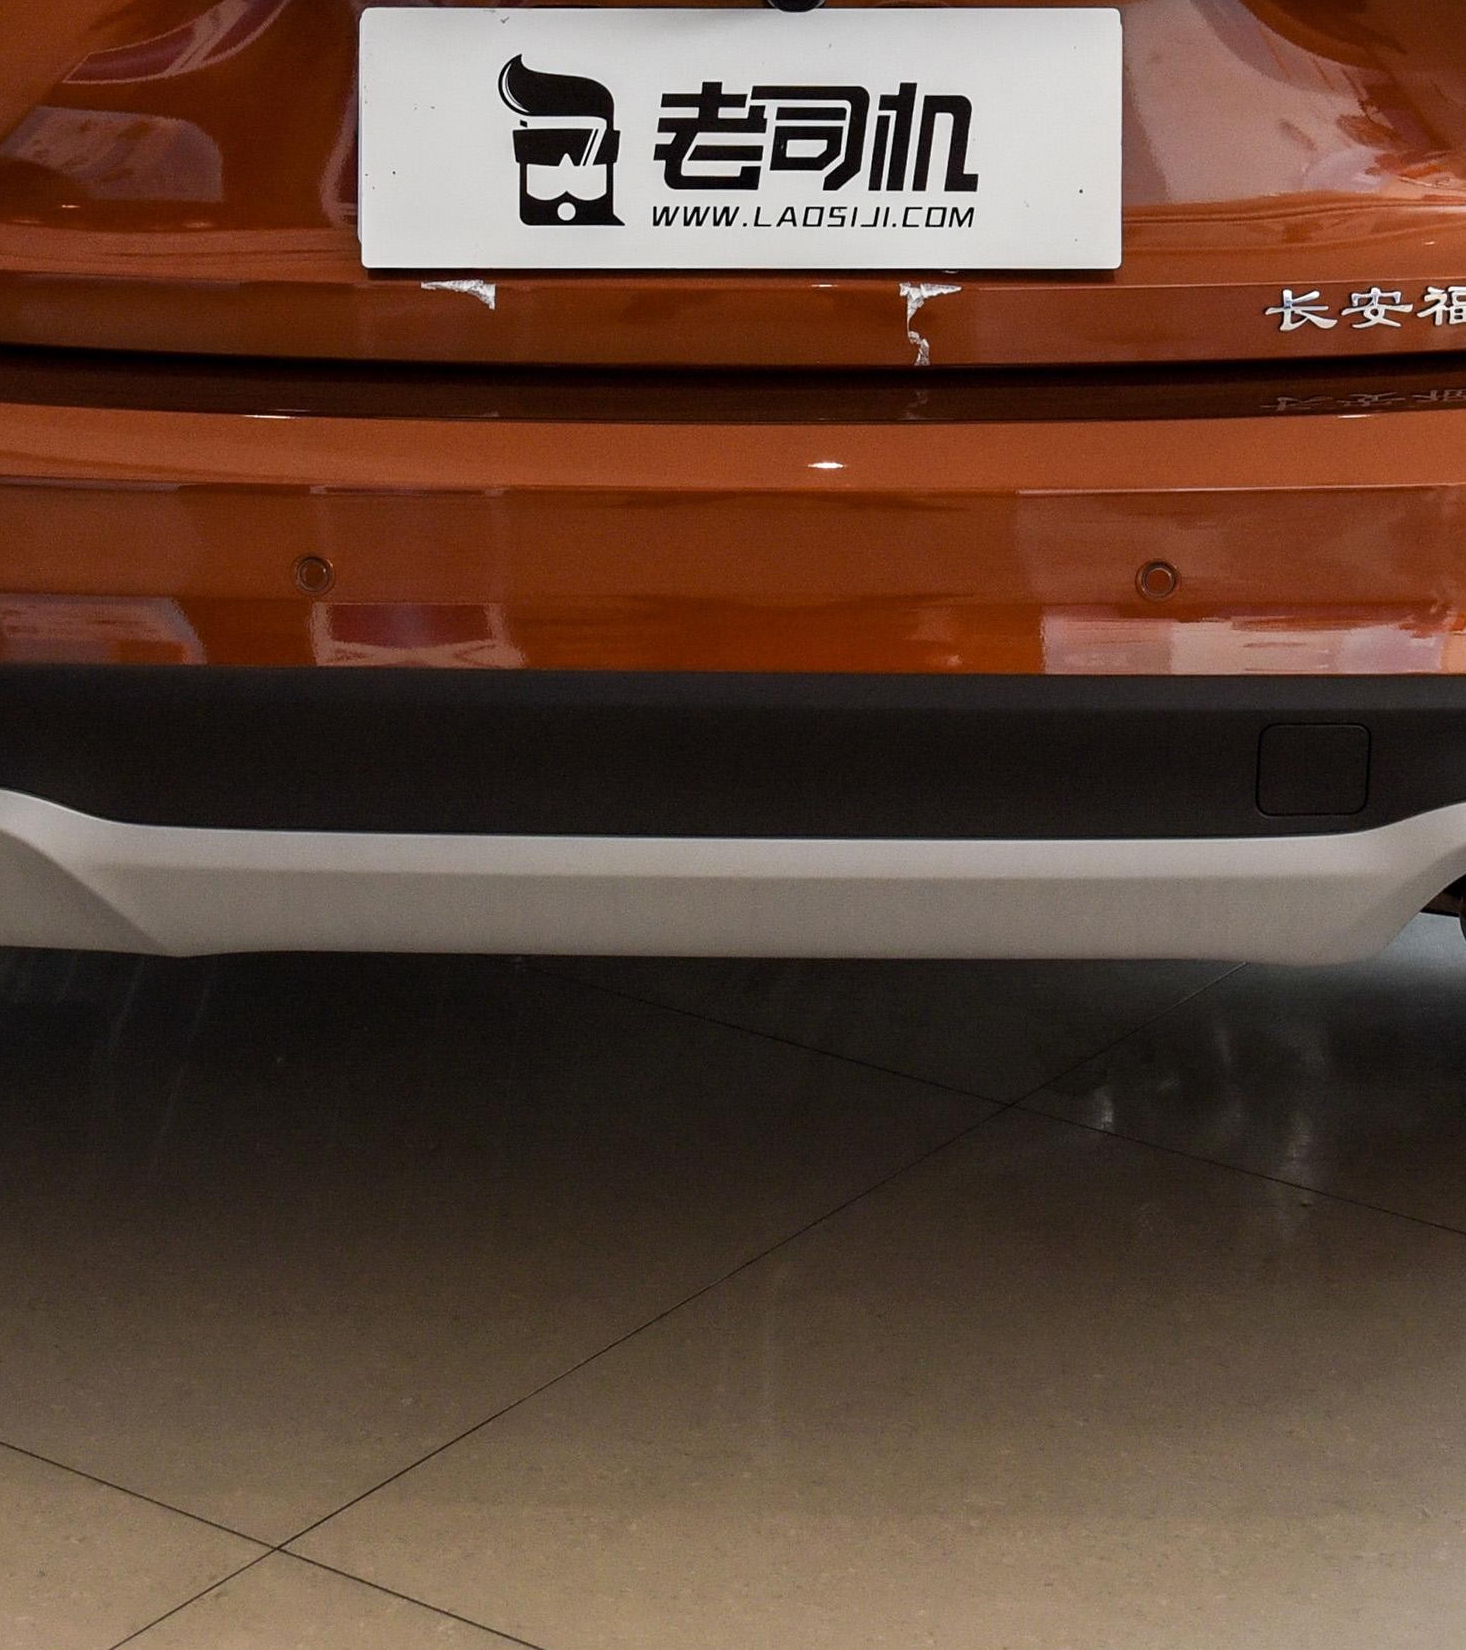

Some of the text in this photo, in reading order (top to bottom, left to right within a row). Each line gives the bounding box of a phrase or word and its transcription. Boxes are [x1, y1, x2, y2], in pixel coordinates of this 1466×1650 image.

[652, 81, 980, 193] 老司机
[651, 205, 976, 229] WWW.LAOSIJI.COM
